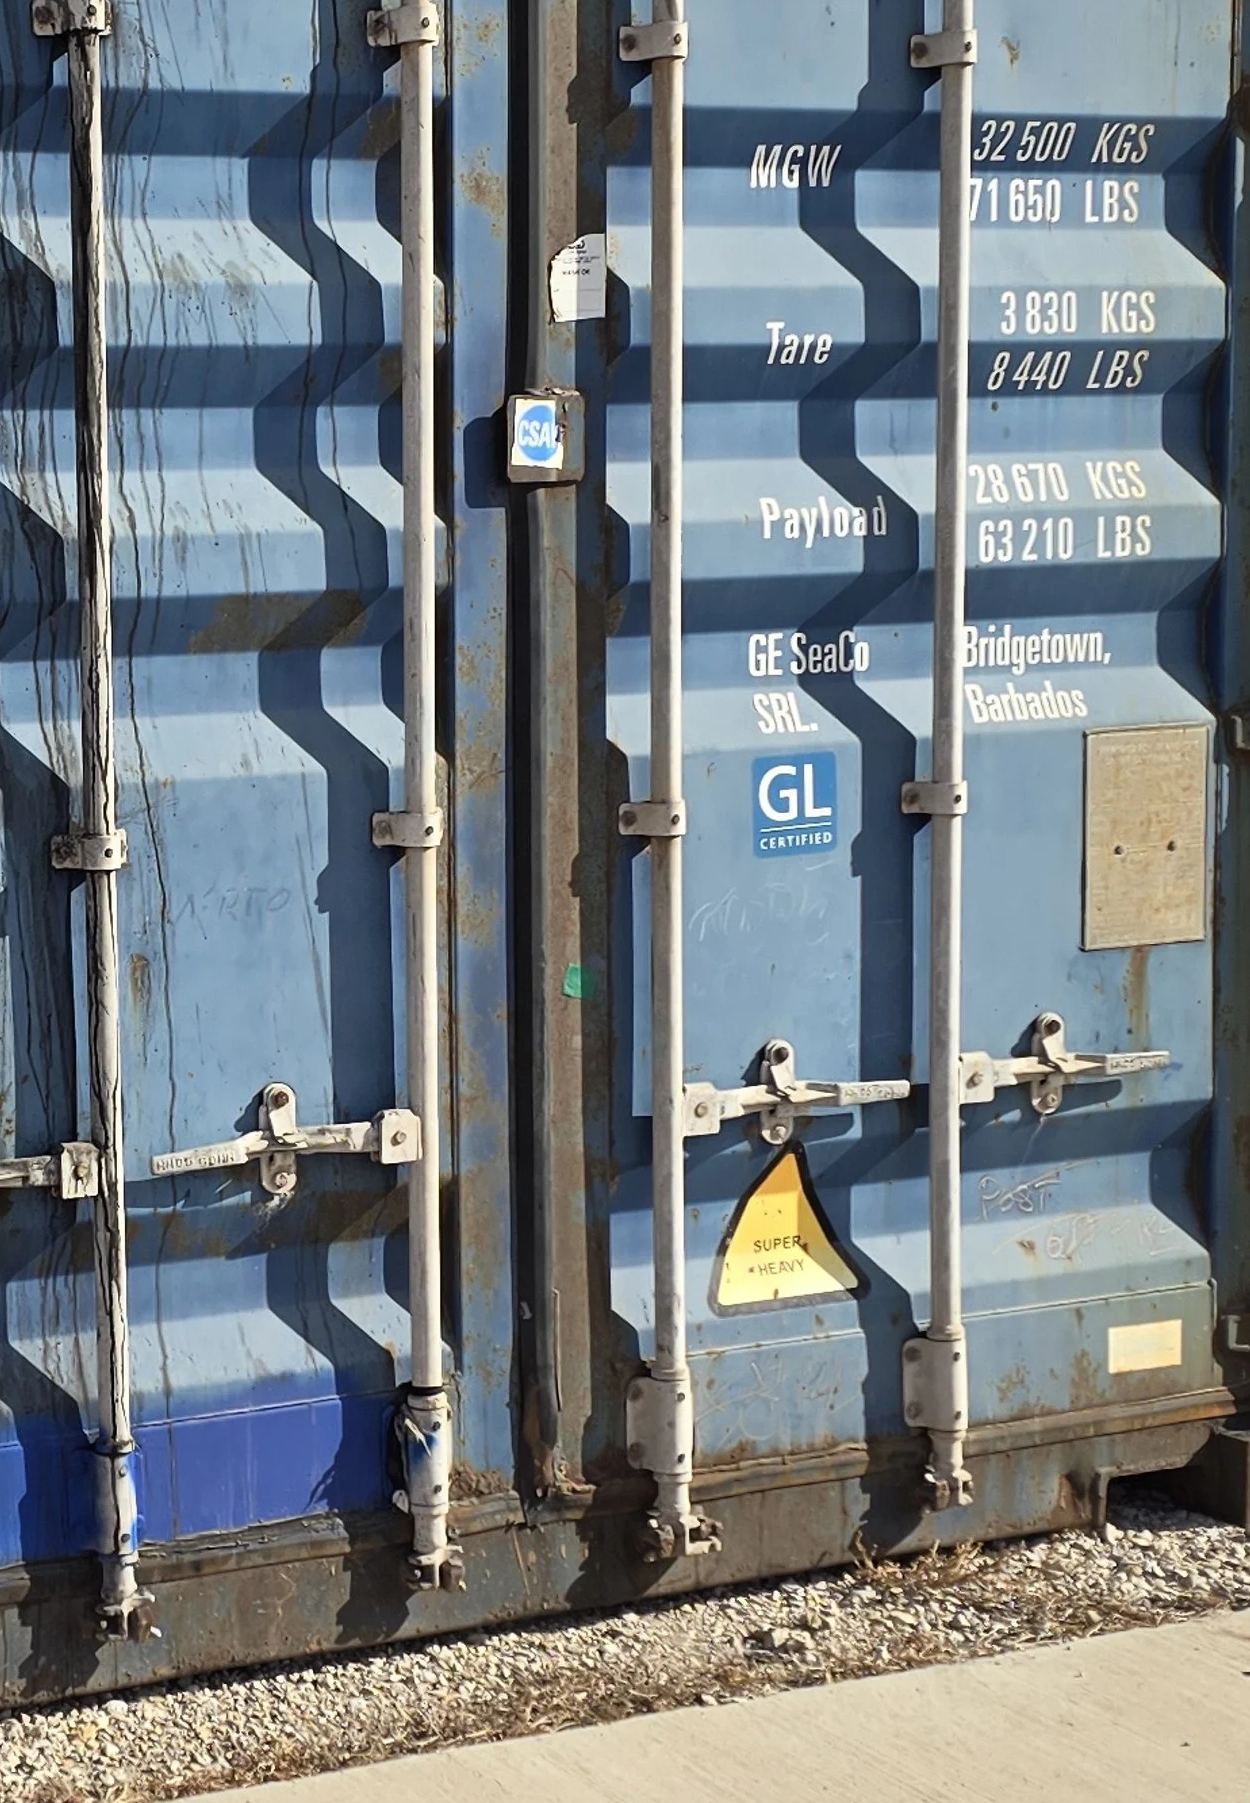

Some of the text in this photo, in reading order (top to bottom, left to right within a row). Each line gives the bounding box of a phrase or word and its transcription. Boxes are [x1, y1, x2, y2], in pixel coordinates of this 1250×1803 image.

[749, 144, 841, 190] MGW
[1091, 123, 1155, 164] KGS
[1084, 180, 1139, 224] LBS
[765, 321, 834, 365] Tare
[1101, 290, 1156, 334] KGS
[1086, 349, 1150, 390] LBS
[759, 495, 888, 549] Payload
[1085, 459, 1148, 501] KGS
[1096, 514, 1152, 558] LBS
[748, 630, 871, 677] GE SeaCo
[961, 623, 1112, 677] Bridgetown,
[752, 691, 819, 734] SRL.
[965, 680, 1088, 725] Barbados
[758, 762, 832, 822] GL
[759, 830, 833, 851] CERTIFIED
[753, 1235, 801, 1254] SUPER
[758, 1258, 805, 1276] HEAVY
